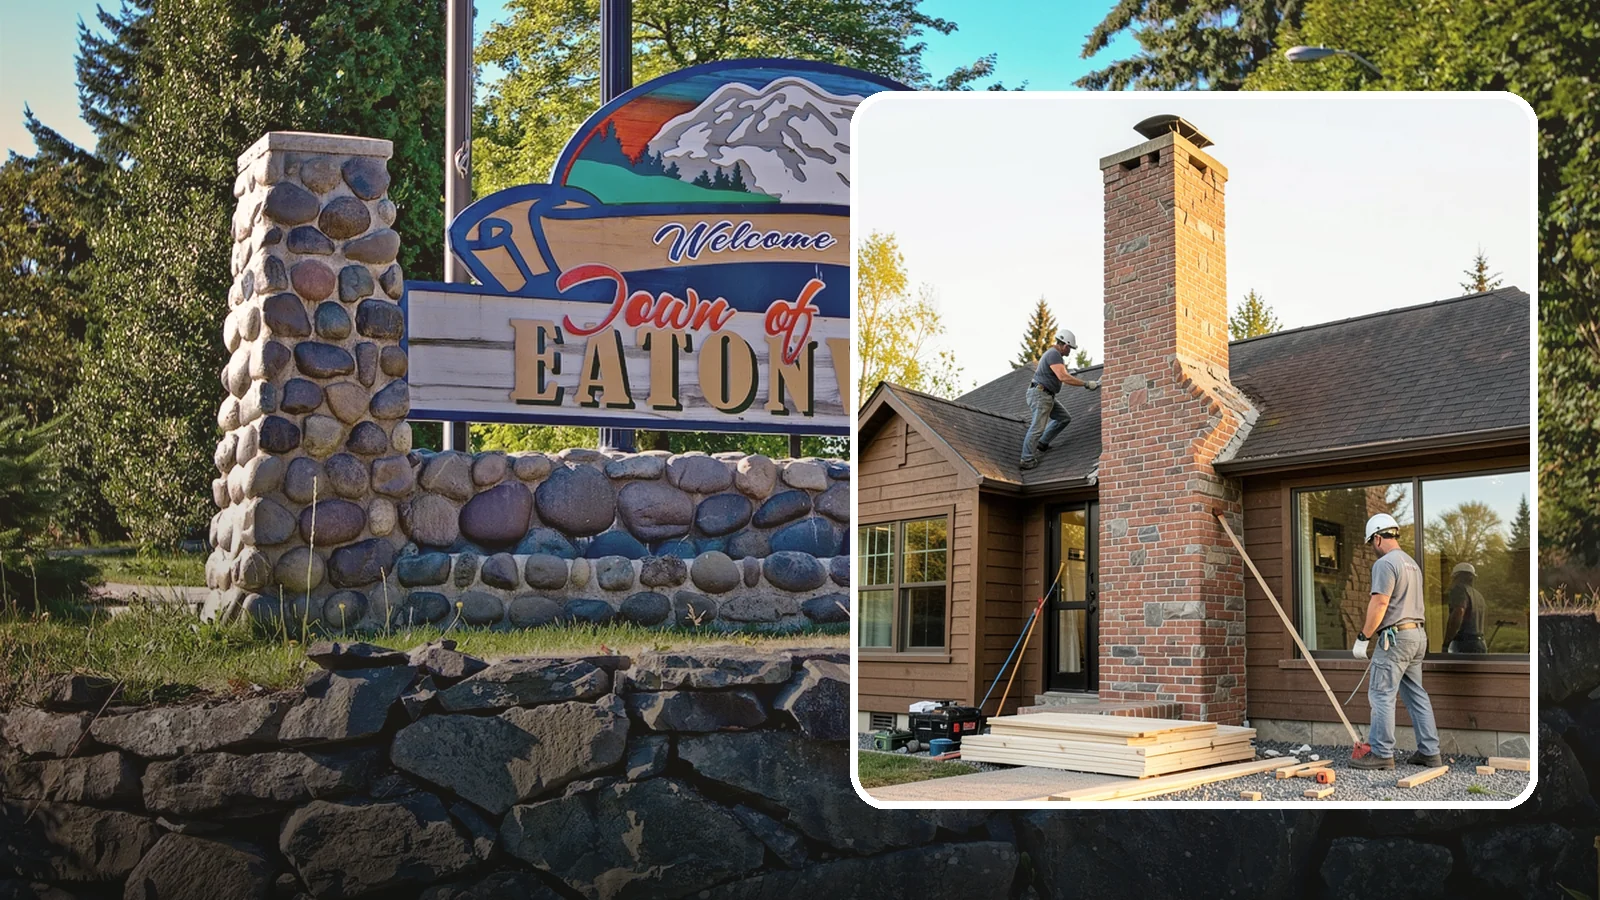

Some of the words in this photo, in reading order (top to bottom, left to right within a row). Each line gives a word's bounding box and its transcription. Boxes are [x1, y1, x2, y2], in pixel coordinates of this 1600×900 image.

[653, 220, 837, 263] Welcome
[558, 264, 736, 335] Town
[764, 278, 826, 366] of
